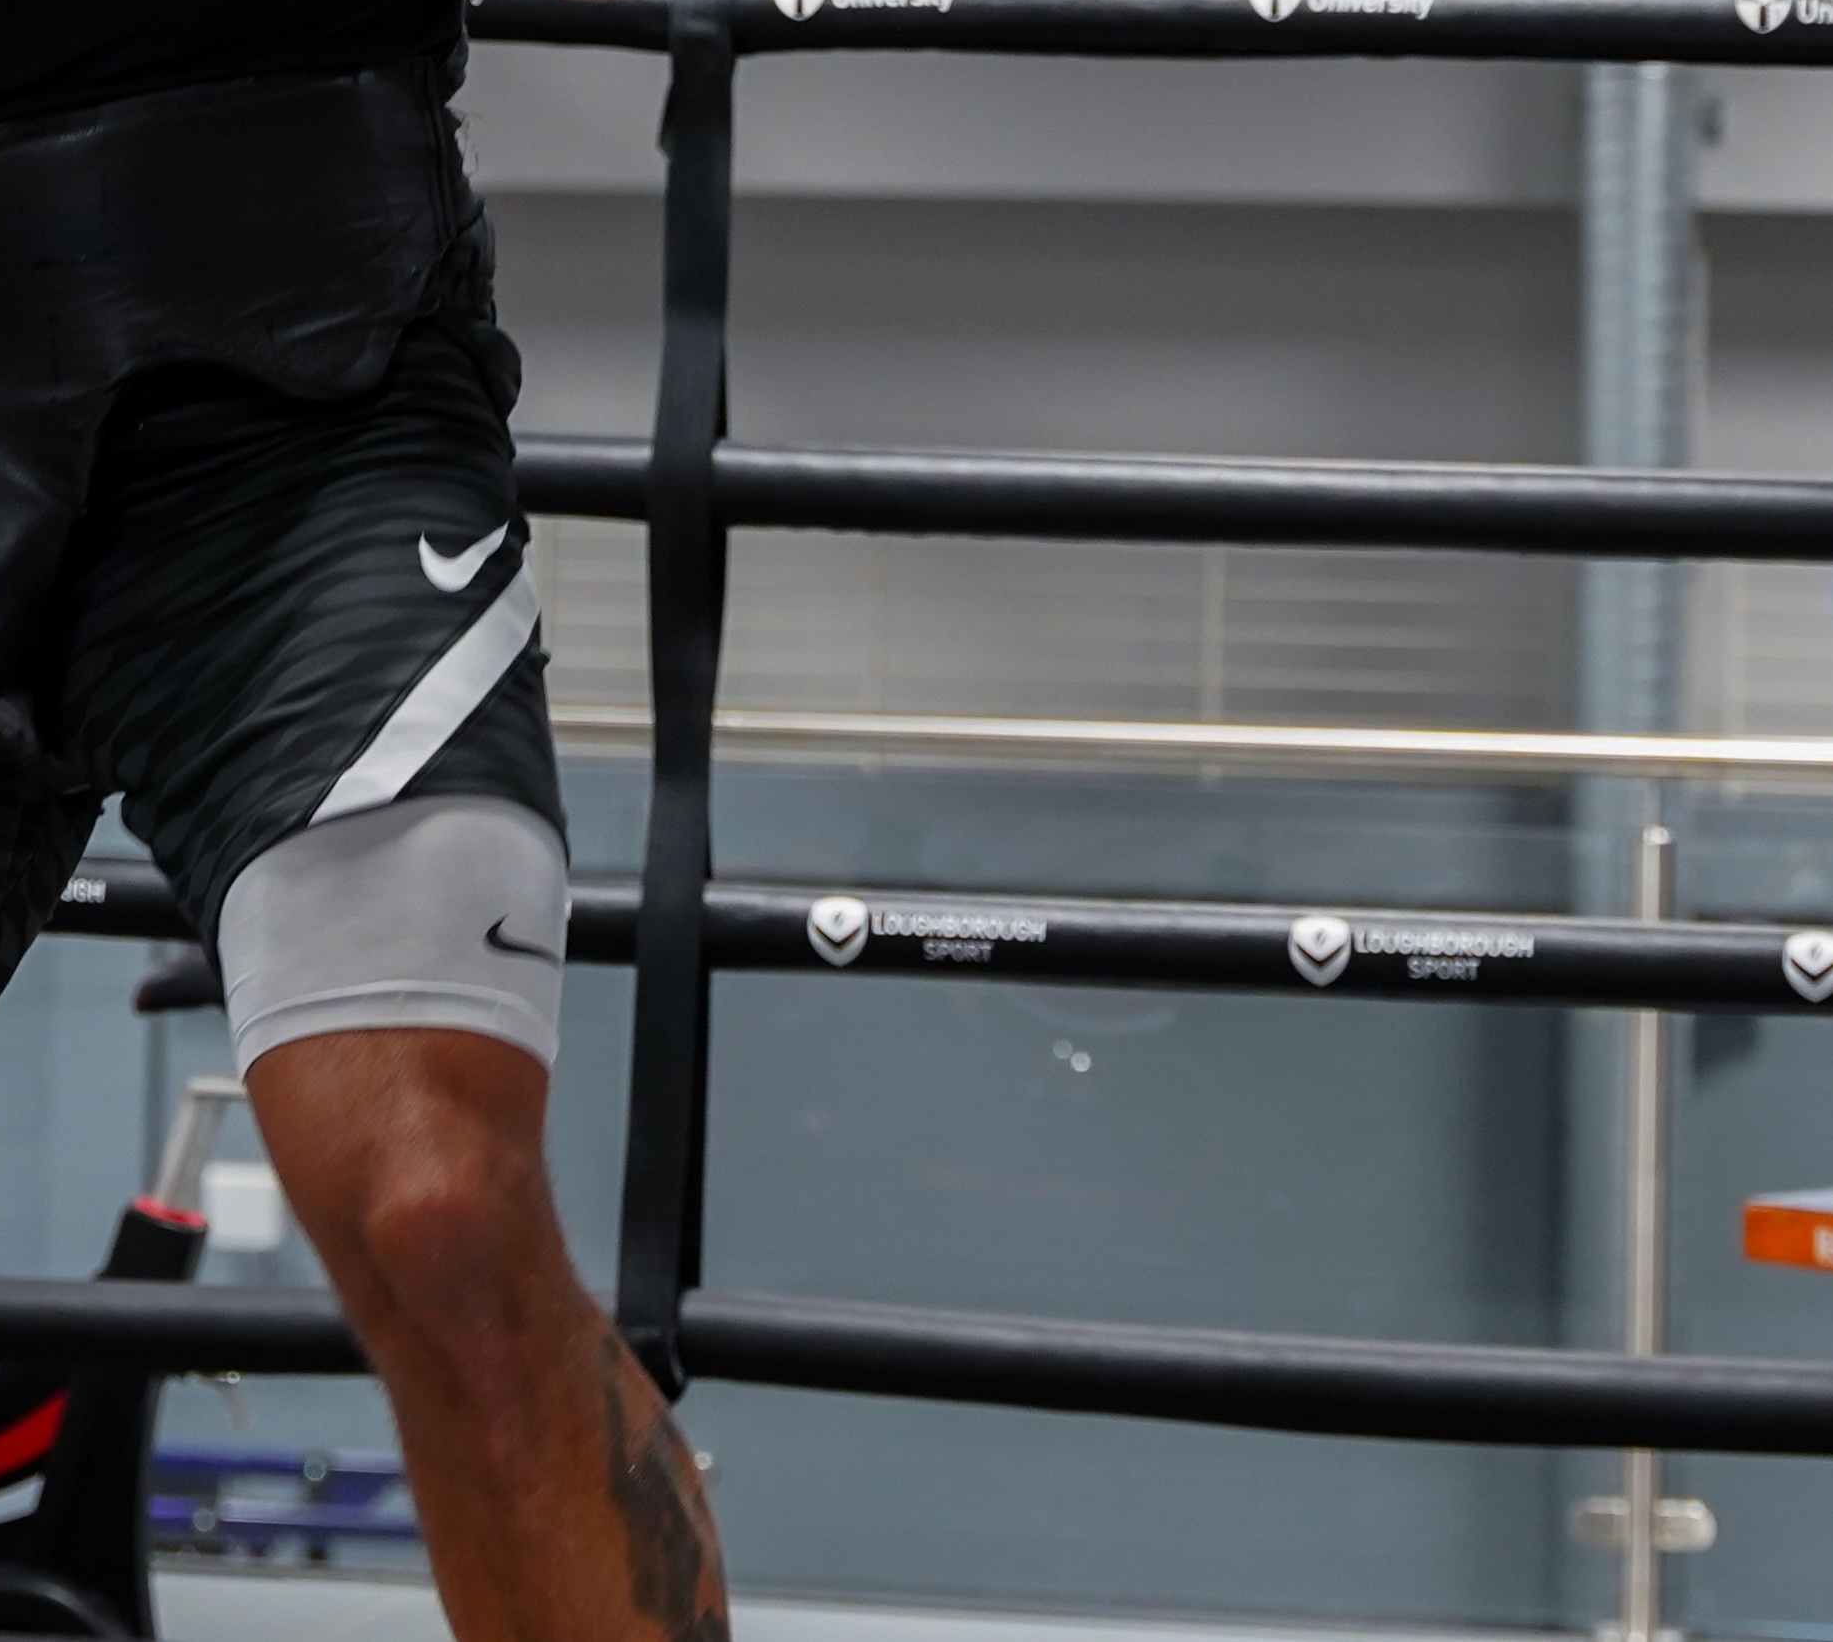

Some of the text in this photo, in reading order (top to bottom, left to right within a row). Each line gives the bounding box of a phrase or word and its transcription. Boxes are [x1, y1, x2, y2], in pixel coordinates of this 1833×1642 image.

[871, 912, 1048, 943] LOUGHBOROUGH
[923, 938, 995, 963] SPORT
[1354, 929, 1535, 957] LOUGHBOROUGH
[1407, 956, 1481, 981] SPORT
